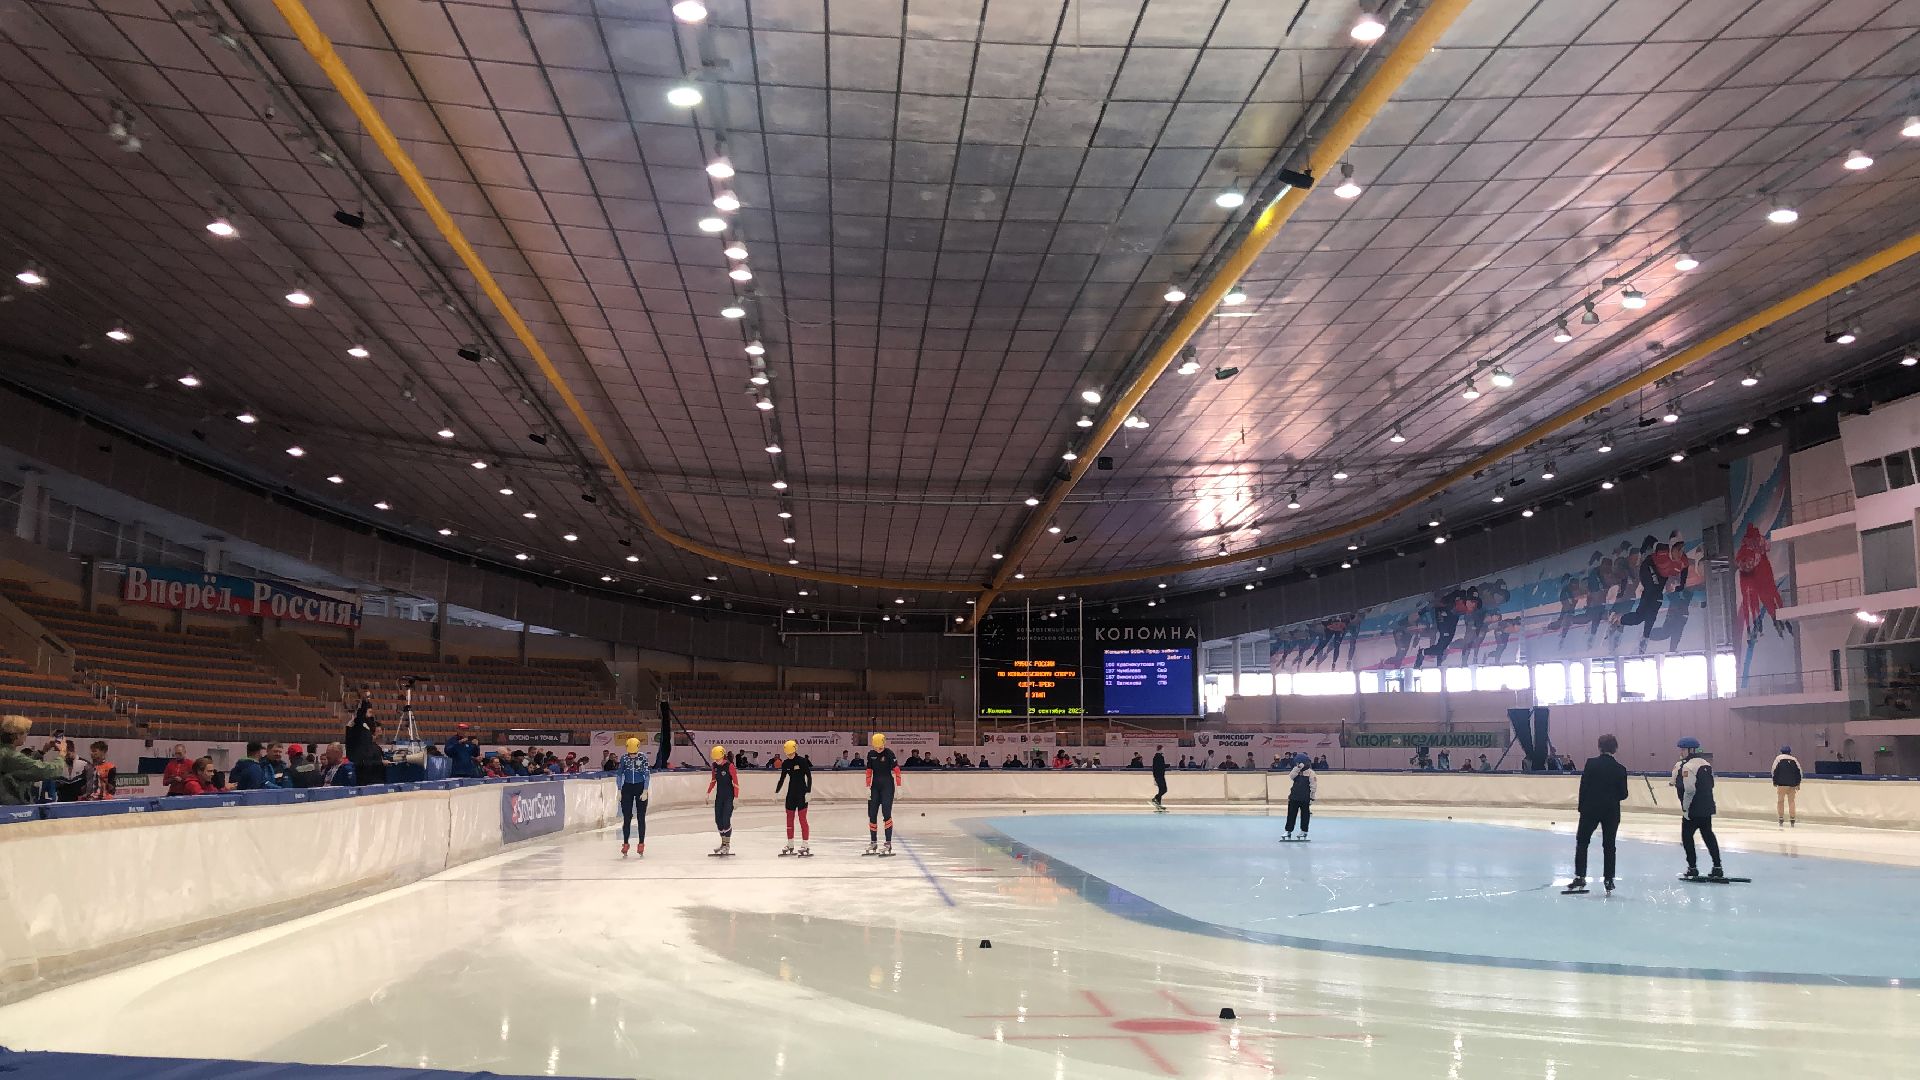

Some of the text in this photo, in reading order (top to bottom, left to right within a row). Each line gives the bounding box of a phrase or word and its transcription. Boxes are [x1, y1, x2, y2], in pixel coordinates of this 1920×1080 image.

[251, 582, 362, 626] Россия!
[1095, 626, 1197, 641] КОЛОМНА
[1355, 734, 1393, 747] СПОРТ
[1448, 734, 1492, 747] ЖИЗНИ
